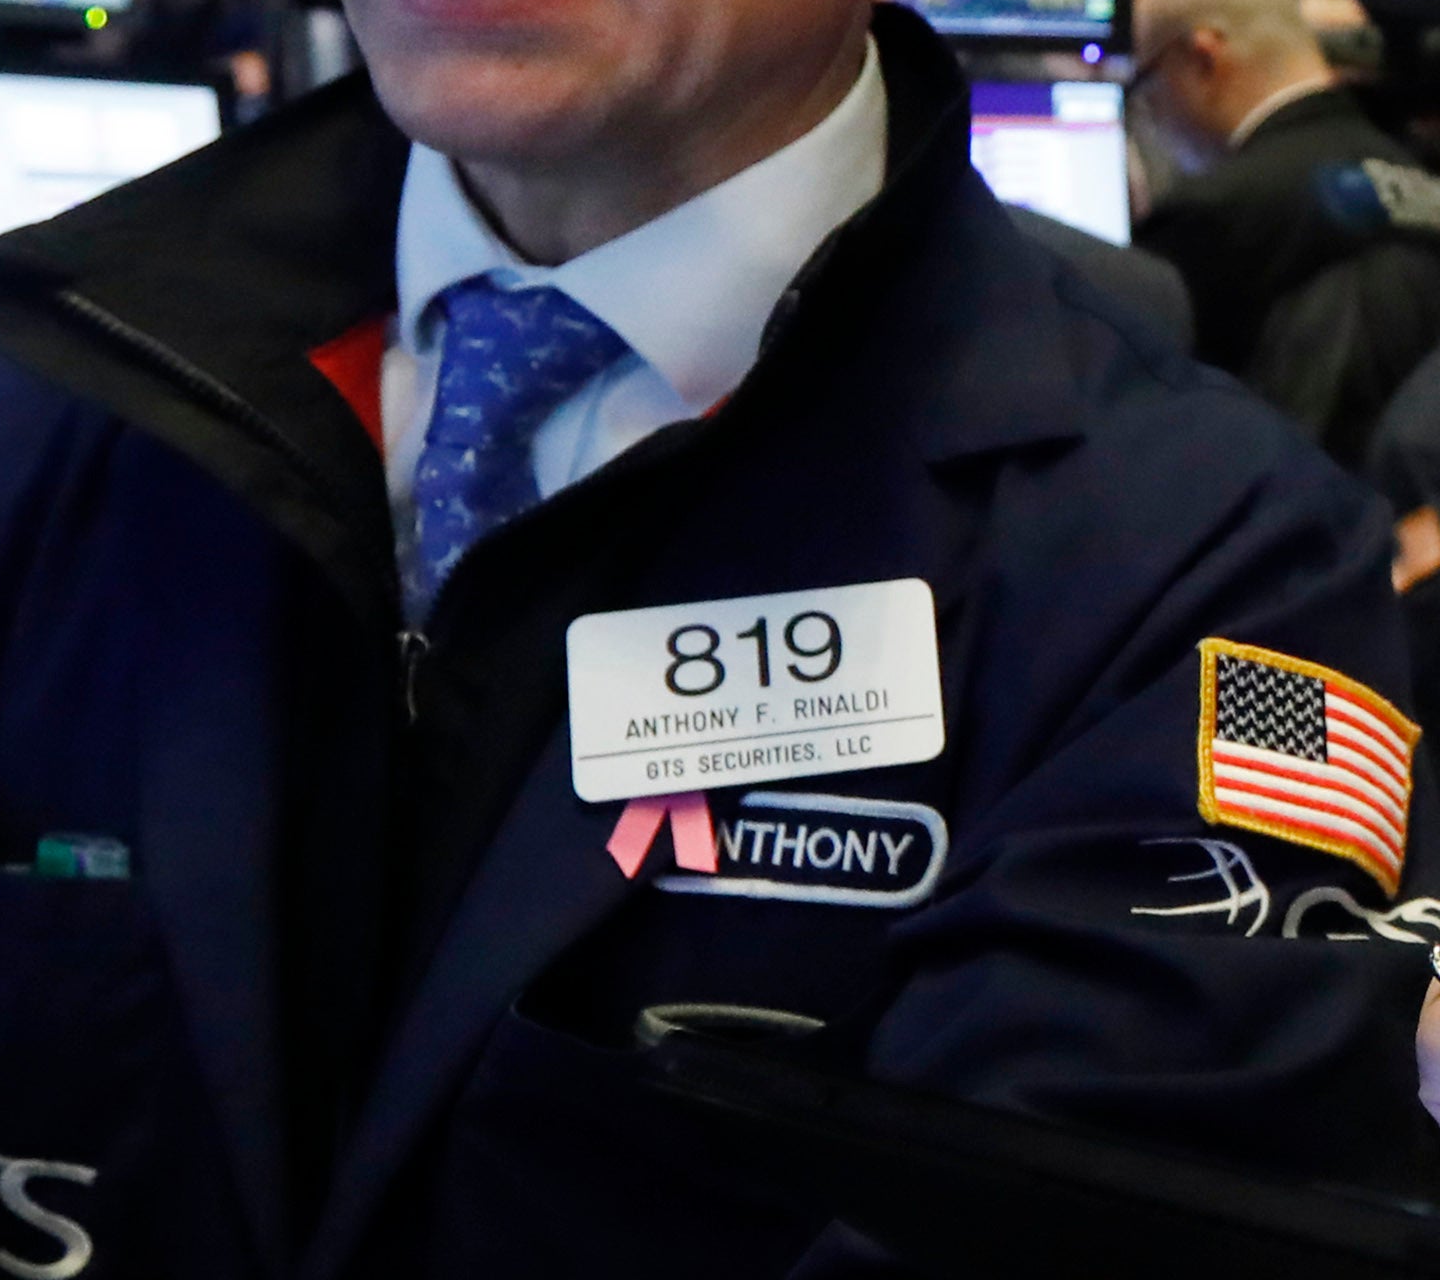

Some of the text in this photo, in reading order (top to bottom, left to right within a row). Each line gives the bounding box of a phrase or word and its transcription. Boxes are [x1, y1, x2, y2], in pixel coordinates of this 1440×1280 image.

[664, 610, 843, 697] 819
[625, 689, 889, 741] ANTHONY F. RINALDI
[646, 758, 685, 780] GTS
[836, 736, 872, 757] LLC
[715, 818, 914, 876] NTHONY
